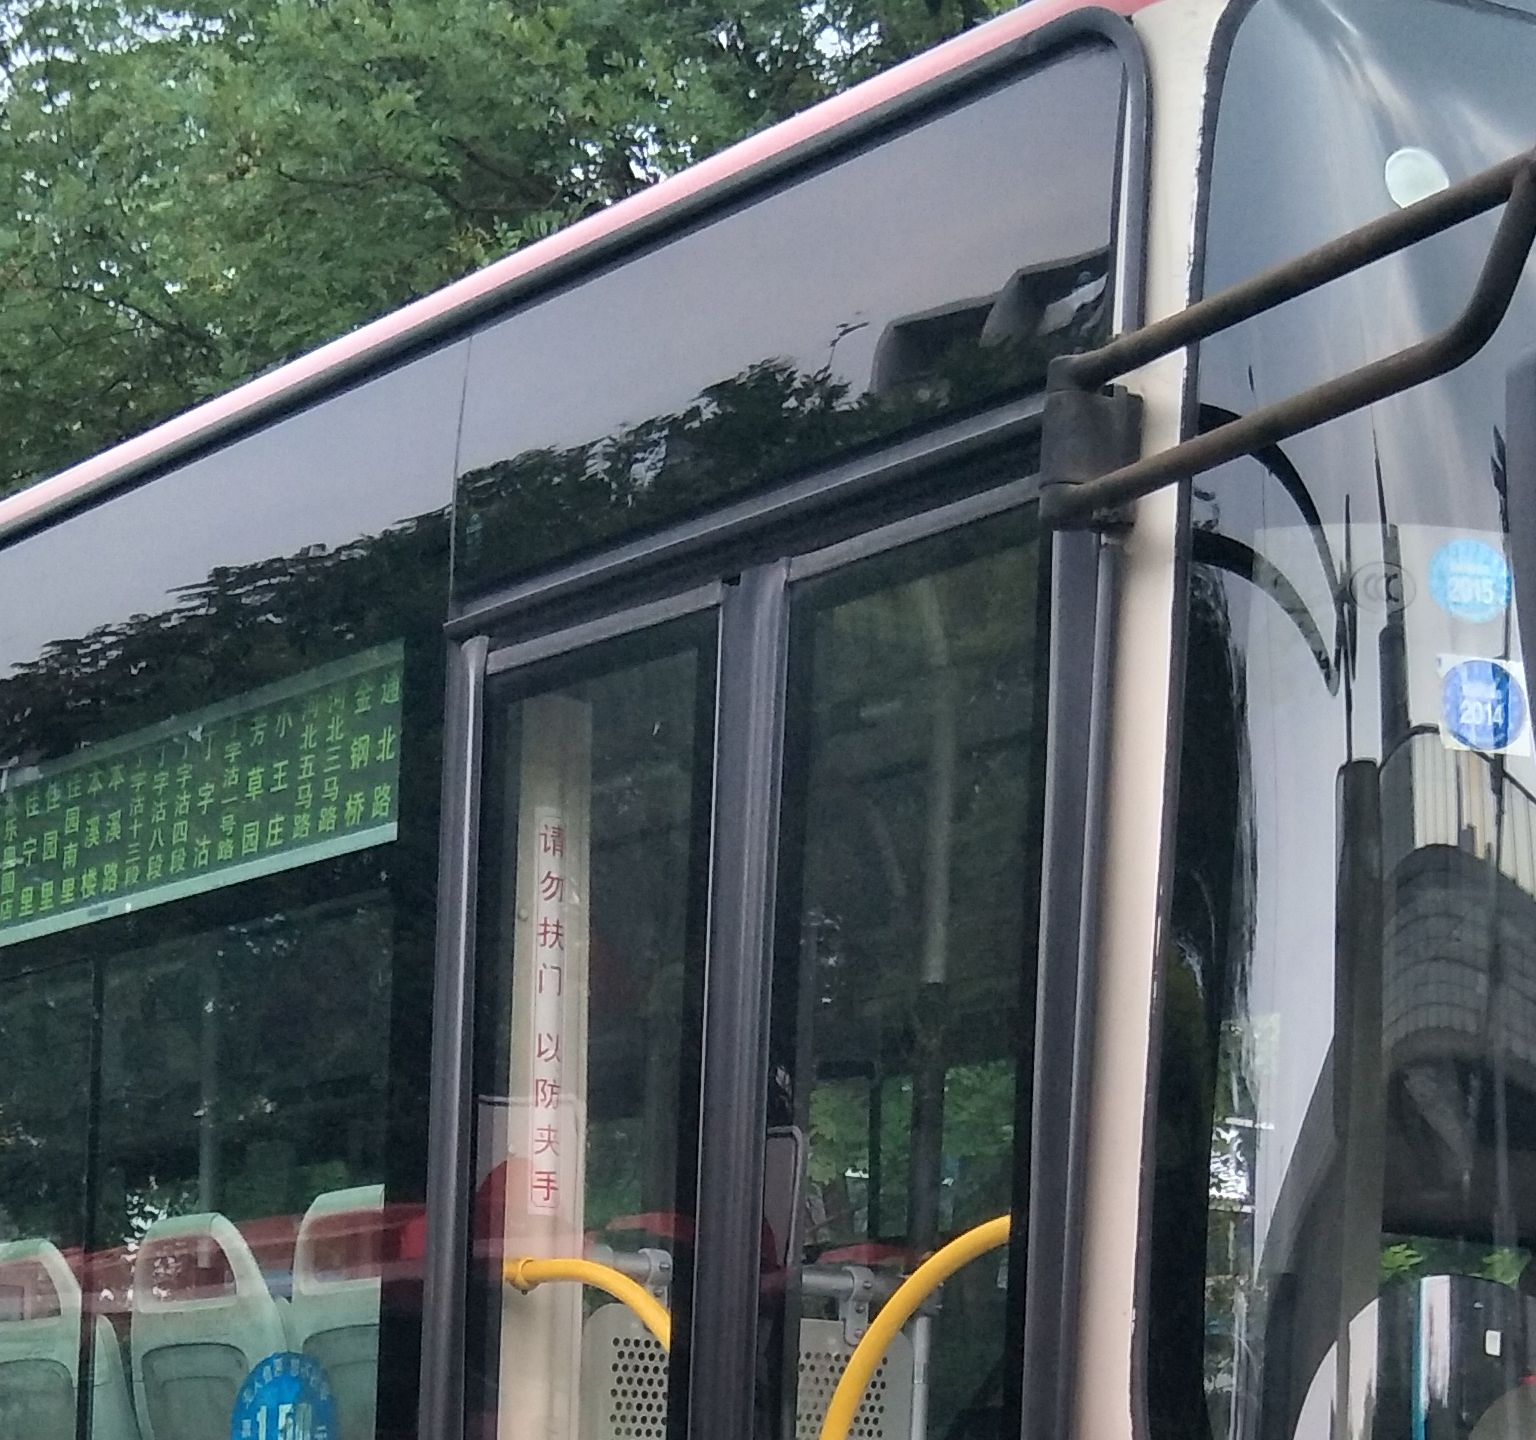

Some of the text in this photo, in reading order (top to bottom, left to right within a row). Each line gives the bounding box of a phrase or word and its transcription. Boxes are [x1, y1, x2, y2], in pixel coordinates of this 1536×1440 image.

[266, 711, 293, 849] 小王庄
[1459, 699, 1505, 727] 2014
[533, 824, 564, 1201] 请勿扶门 以防夹手
